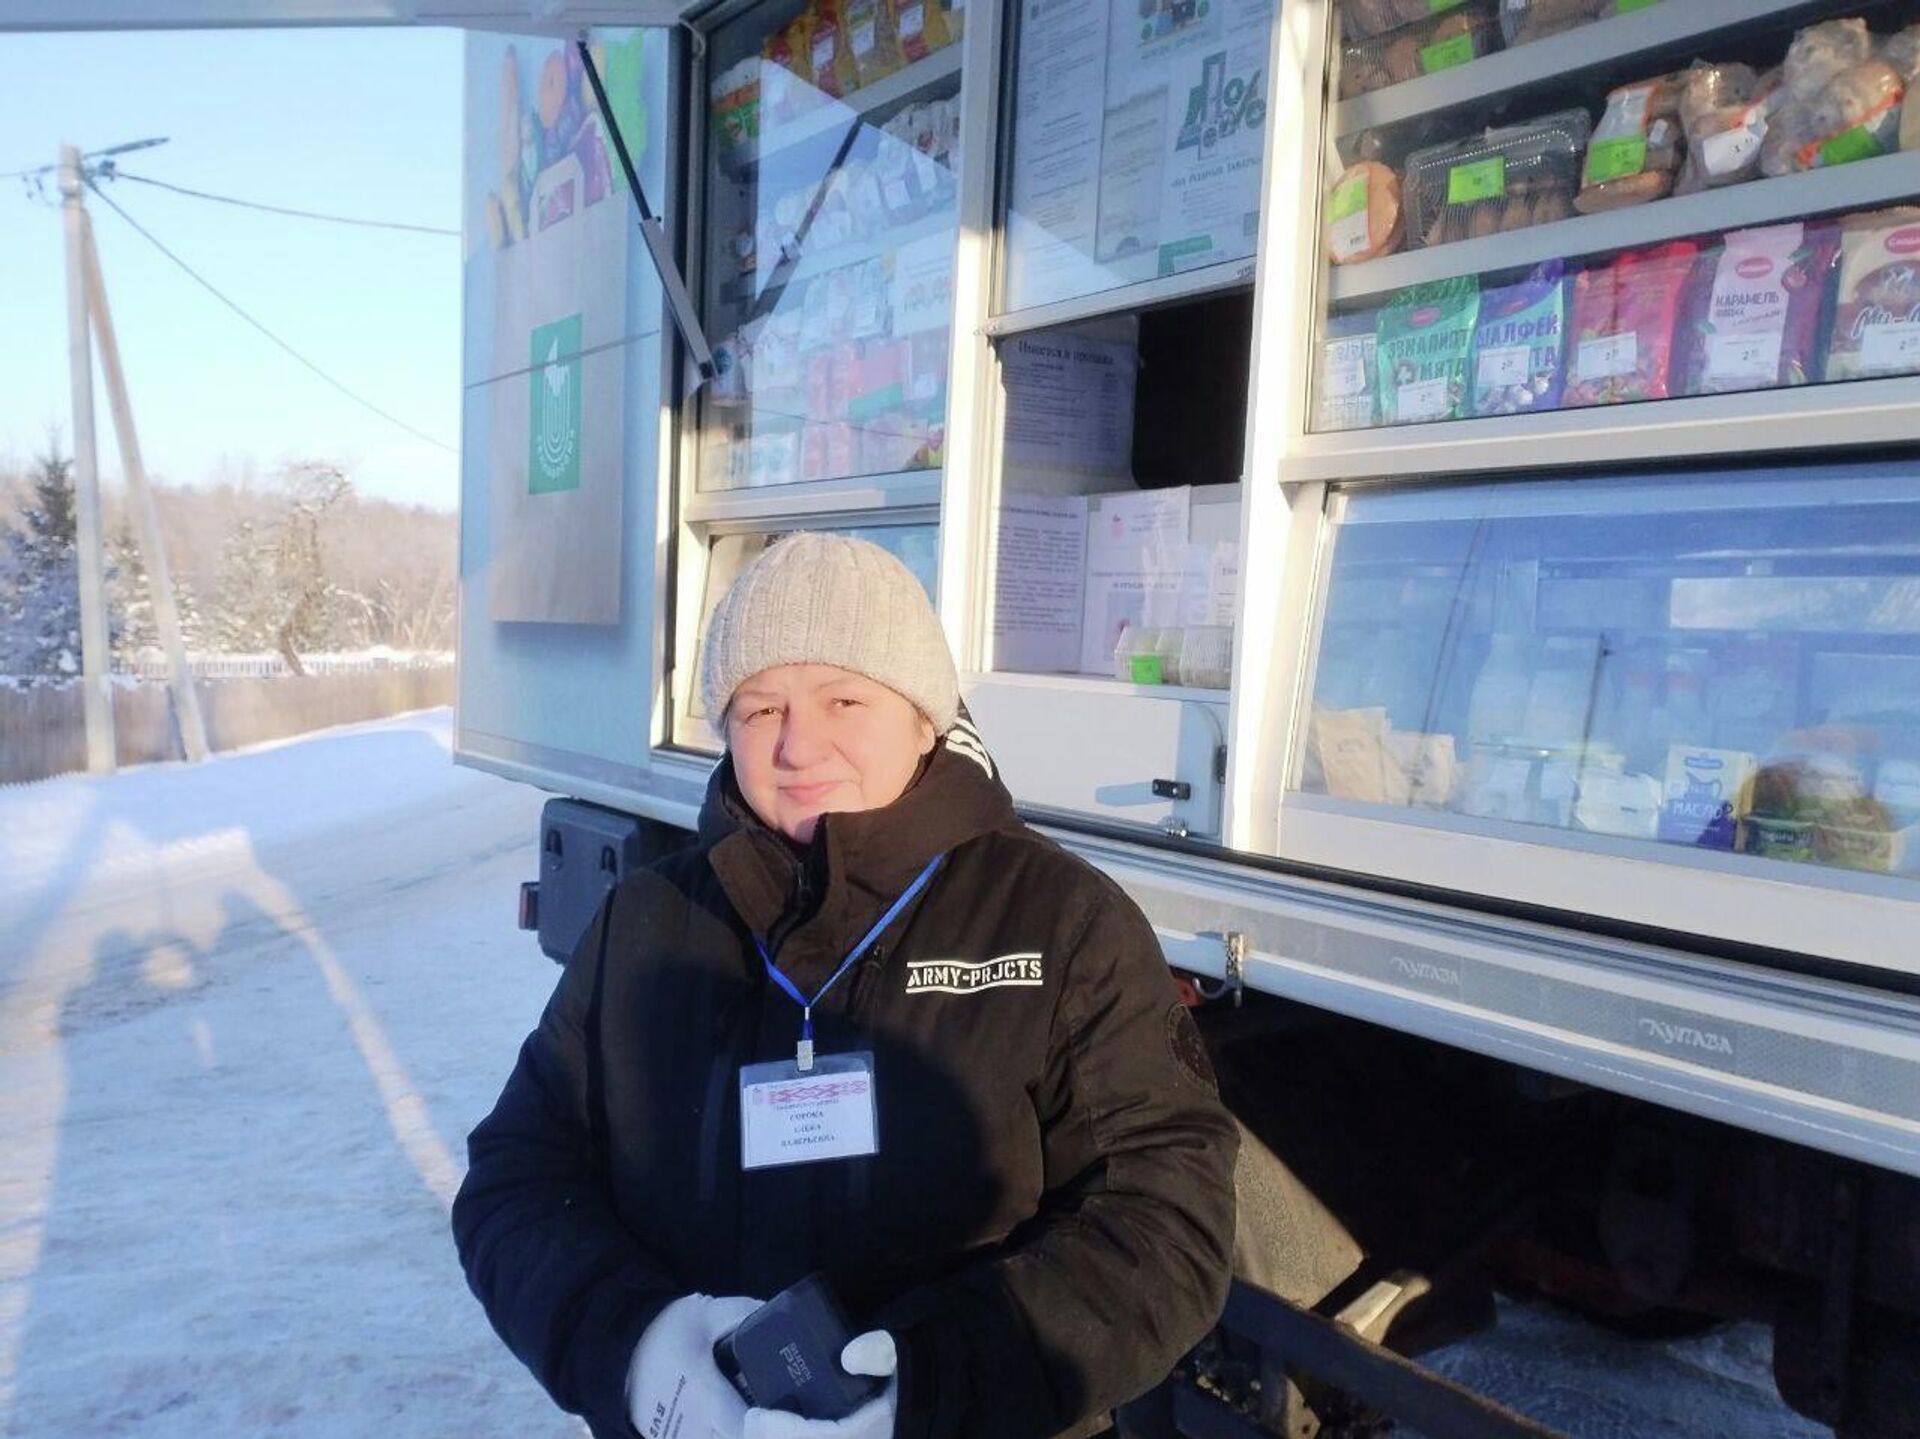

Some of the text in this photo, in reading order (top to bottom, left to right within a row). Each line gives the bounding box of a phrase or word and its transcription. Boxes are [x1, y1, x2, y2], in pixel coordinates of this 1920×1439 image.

[1715, 291, 1780, 307] КАРАМЕЛЬ
[1673, 802, 1724, 818] МАСЛО
[906, 959, 1043, 988] ARMY-PRJCTS
